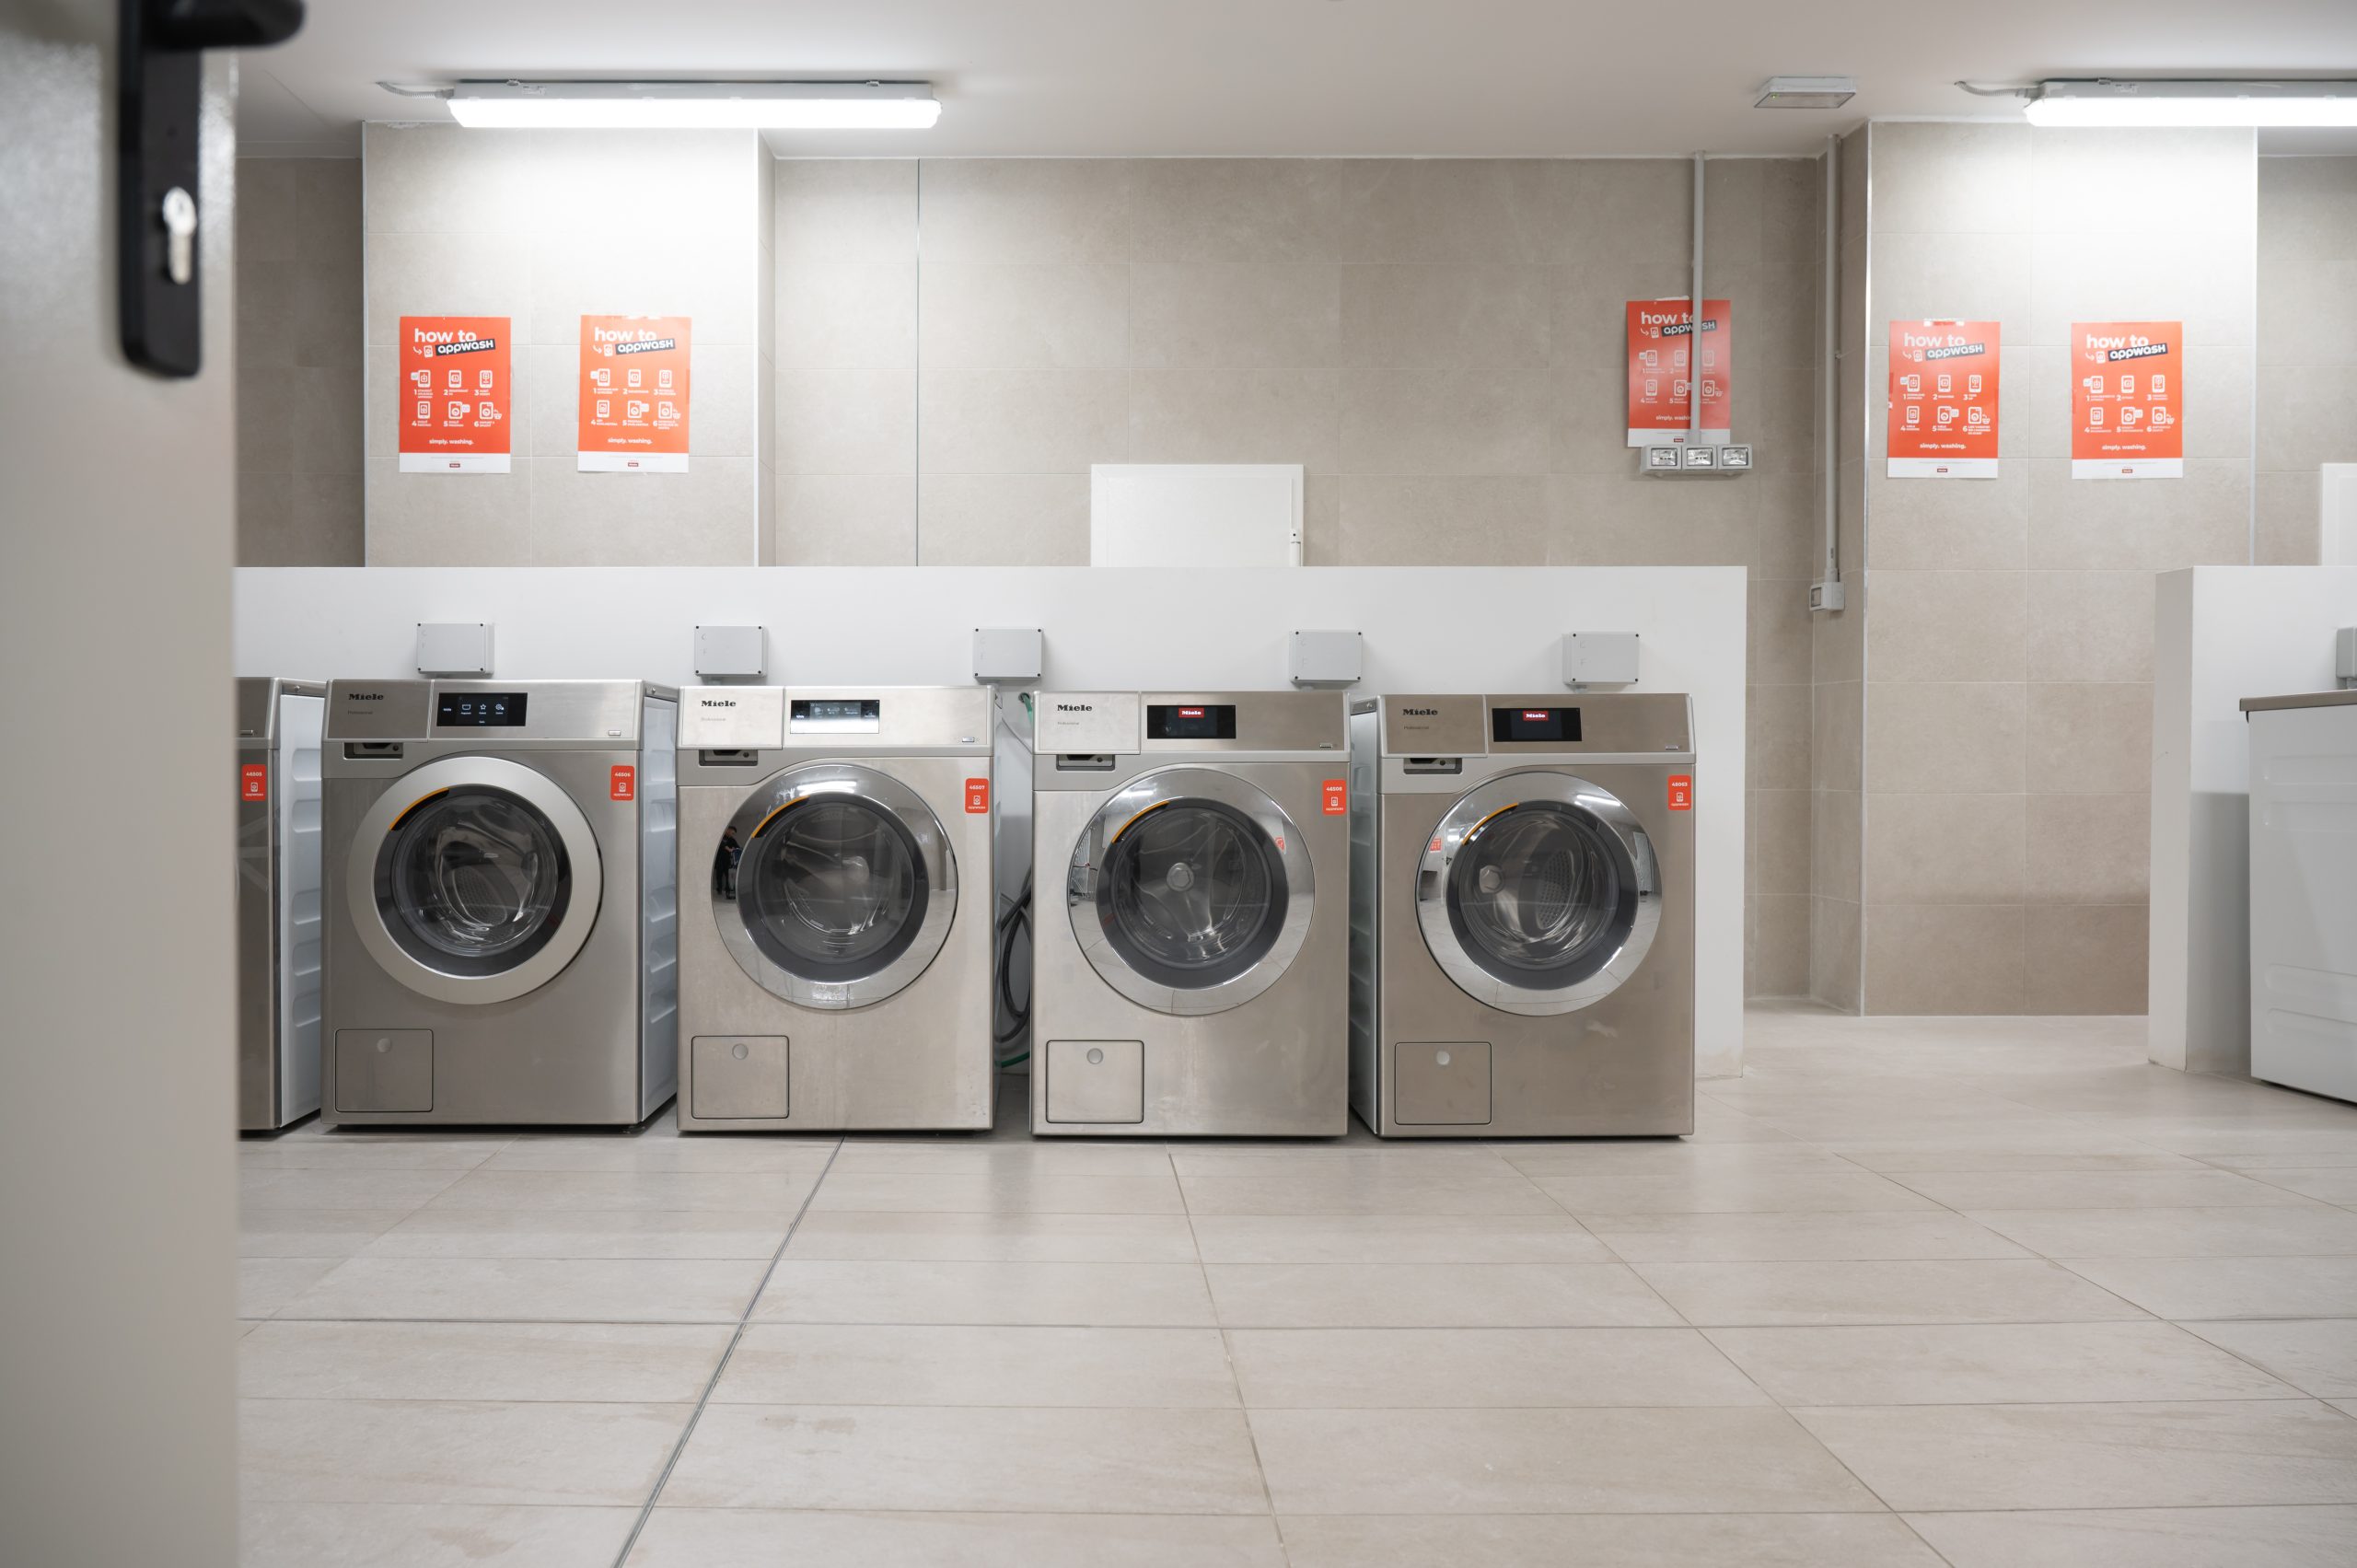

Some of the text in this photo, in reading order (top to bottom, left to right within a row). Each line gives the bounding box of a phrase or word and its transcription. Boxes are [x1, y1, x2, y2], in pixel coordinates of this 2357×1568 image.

[1641, 311, 1677, 324] how
[414, 328, 476, 343] how to
[595, 327, 656, 342] how to
[1904, 332, 1966, 347] how to
[2086, 334, 2149, 349] how to
